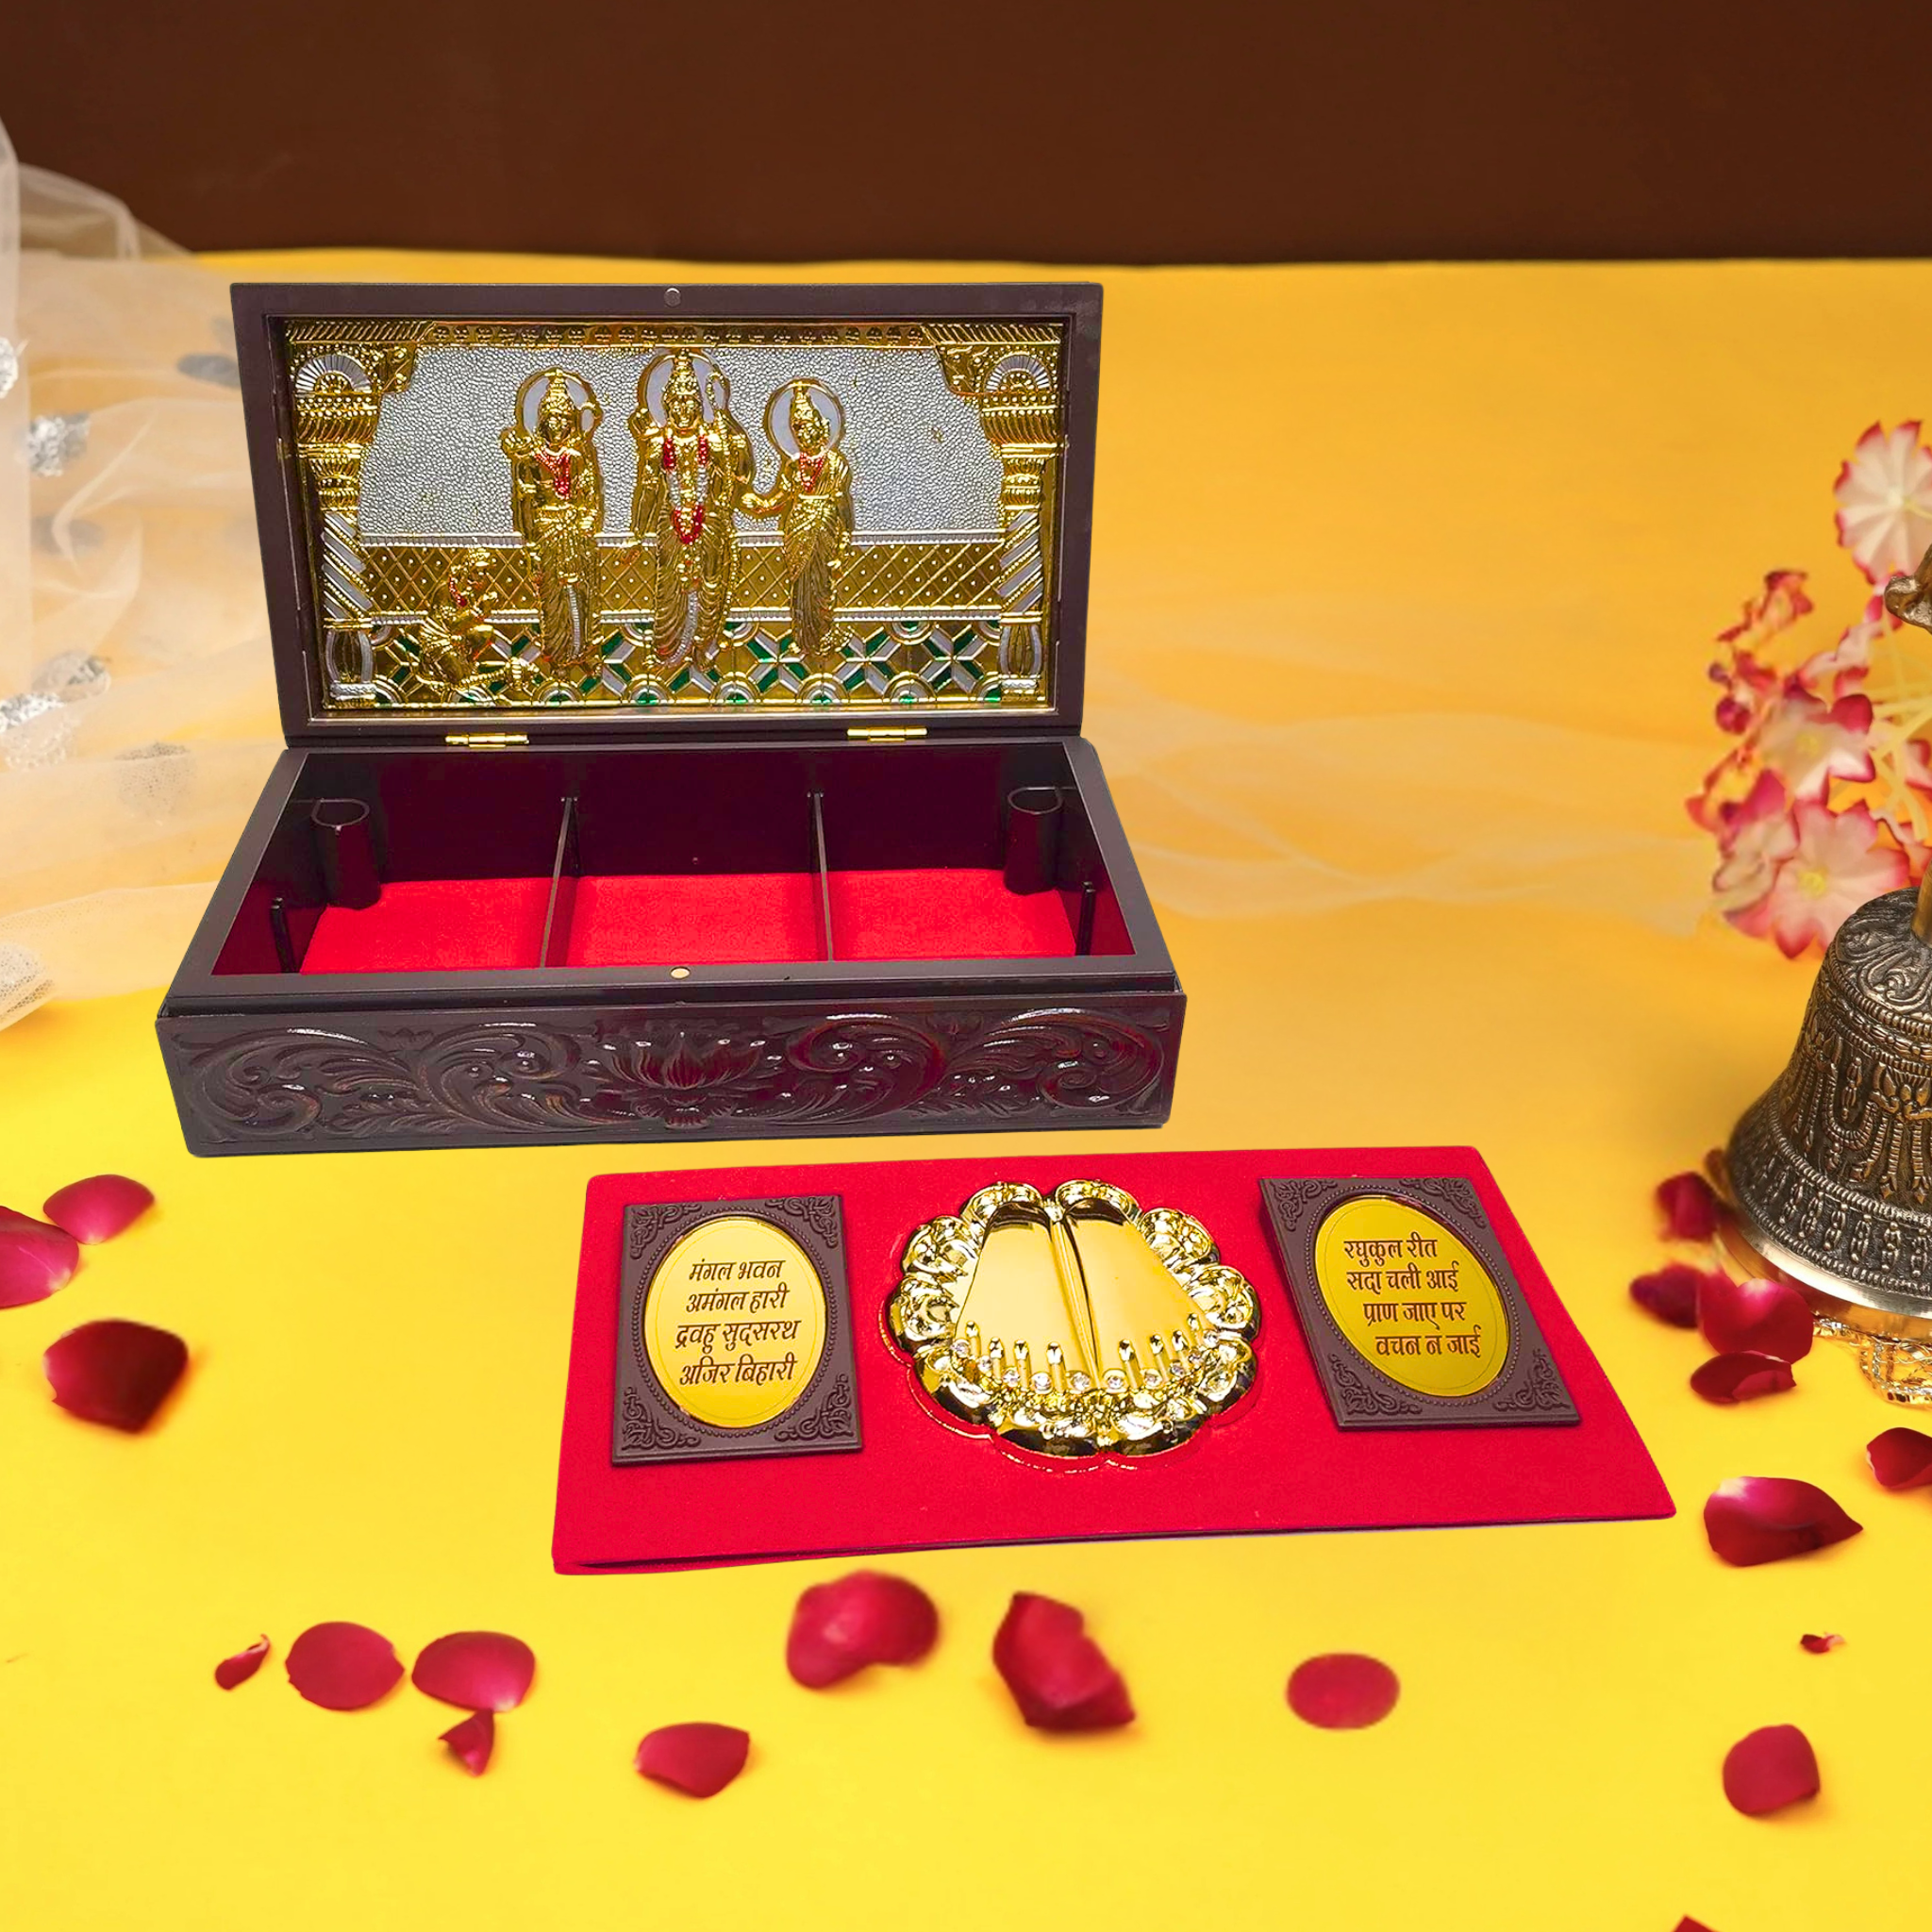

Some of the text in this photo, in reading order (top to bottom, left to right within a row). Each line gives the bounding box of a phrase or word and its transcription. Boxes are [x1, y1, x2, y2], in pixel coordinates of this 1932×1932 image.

[1343, 1231, 1438, 1267] रघुकुल रीत
[689, 1258, 786, 1281] मंगल भवन
[1346, 1260, 1459, 1294] सदा चली आई
[686, 1282, 790, 1313] अमंगल हारी
[1363, 1302, 1467, 1330] प्राण जाए पर
[1375, 1324, 1481, 1357] वचन न जाई
[679, 1351, 797, 1385] अजिर बिहारी
